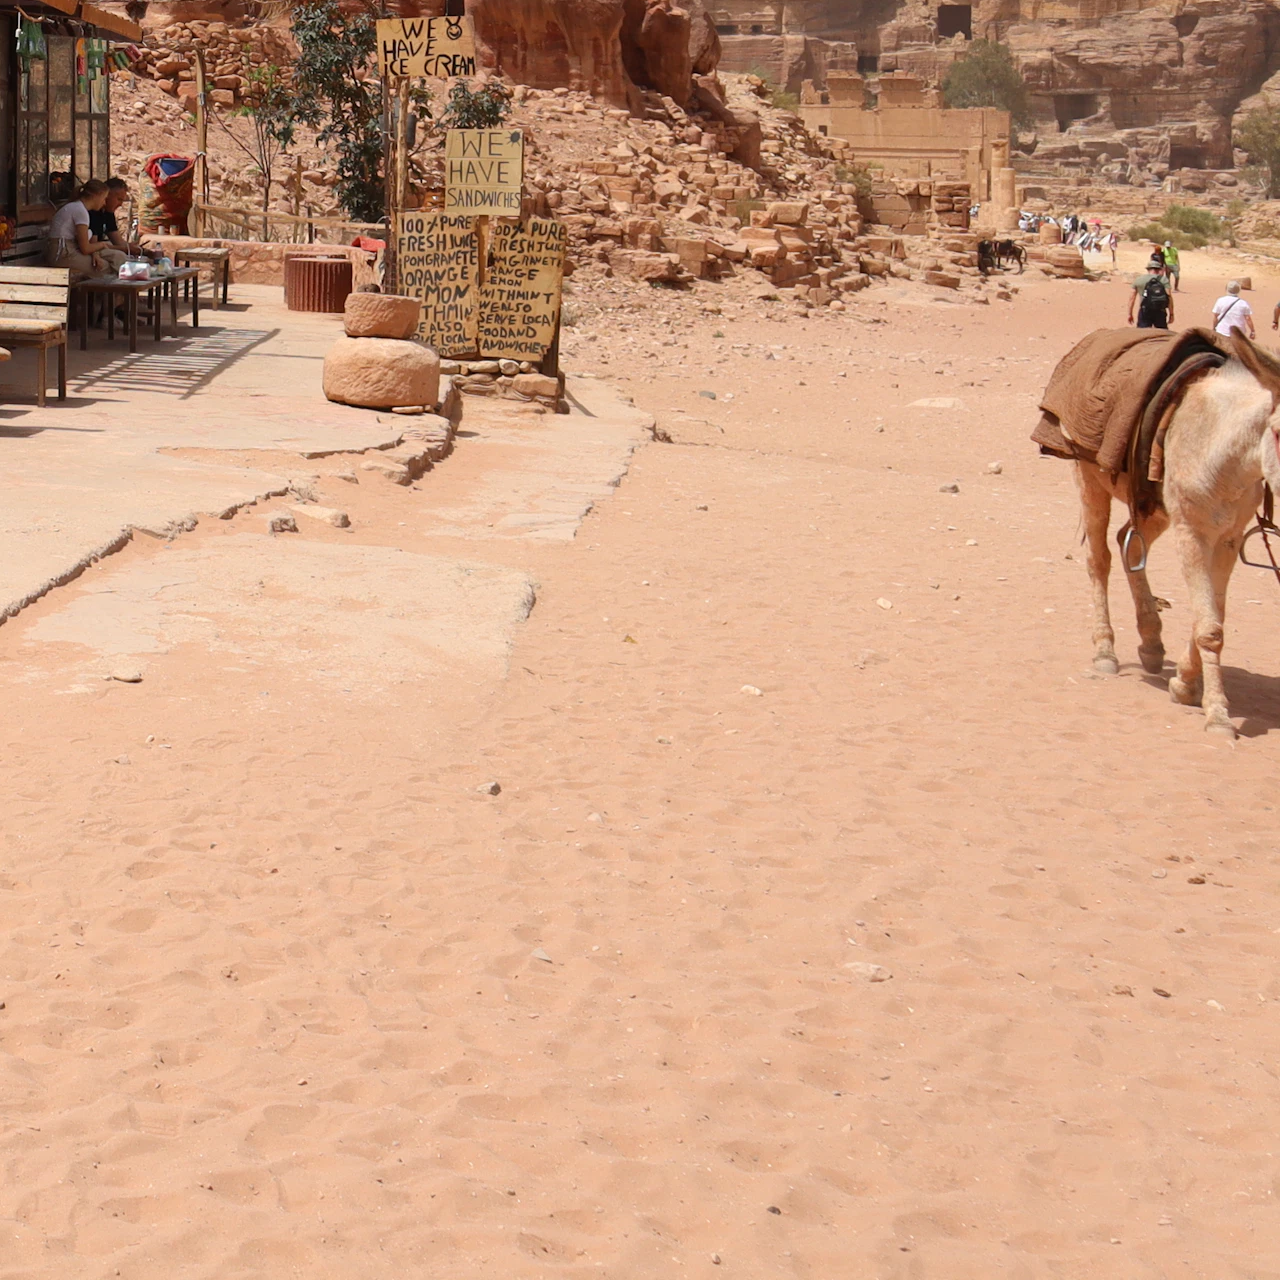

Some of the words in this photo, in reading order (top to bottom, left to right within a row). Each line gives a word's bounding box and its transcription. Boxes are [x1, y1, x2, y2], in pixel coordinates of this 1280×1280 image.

[401, 17, 437, 39] WE
[383, 39, 438, 62] HAVE
[424, 54, 476, 76] CREAM
[459, 131, 503, 158] WE
[450, 160, 509, 184] HAVE
[447, 187, 521, 209] SANDWICHES
[440, 215, 473, 231] PURE
[531, 222, 568, 241] PURE
[398, 233, 447, 254] FRESH
[403, 249, 478, 269] POMGRANETE
[405, 265, 469, 287] ORANGE
[487, 276, 522, 287] EMON
[490, 266, 540, 280] RANGE
[430, 321, 462, 333] ALSO
[479, 311, 516, 325] SERVE
[441, 328, 471, 346] LOCAL
[479, 338, 548, 354] ANDWICHES
